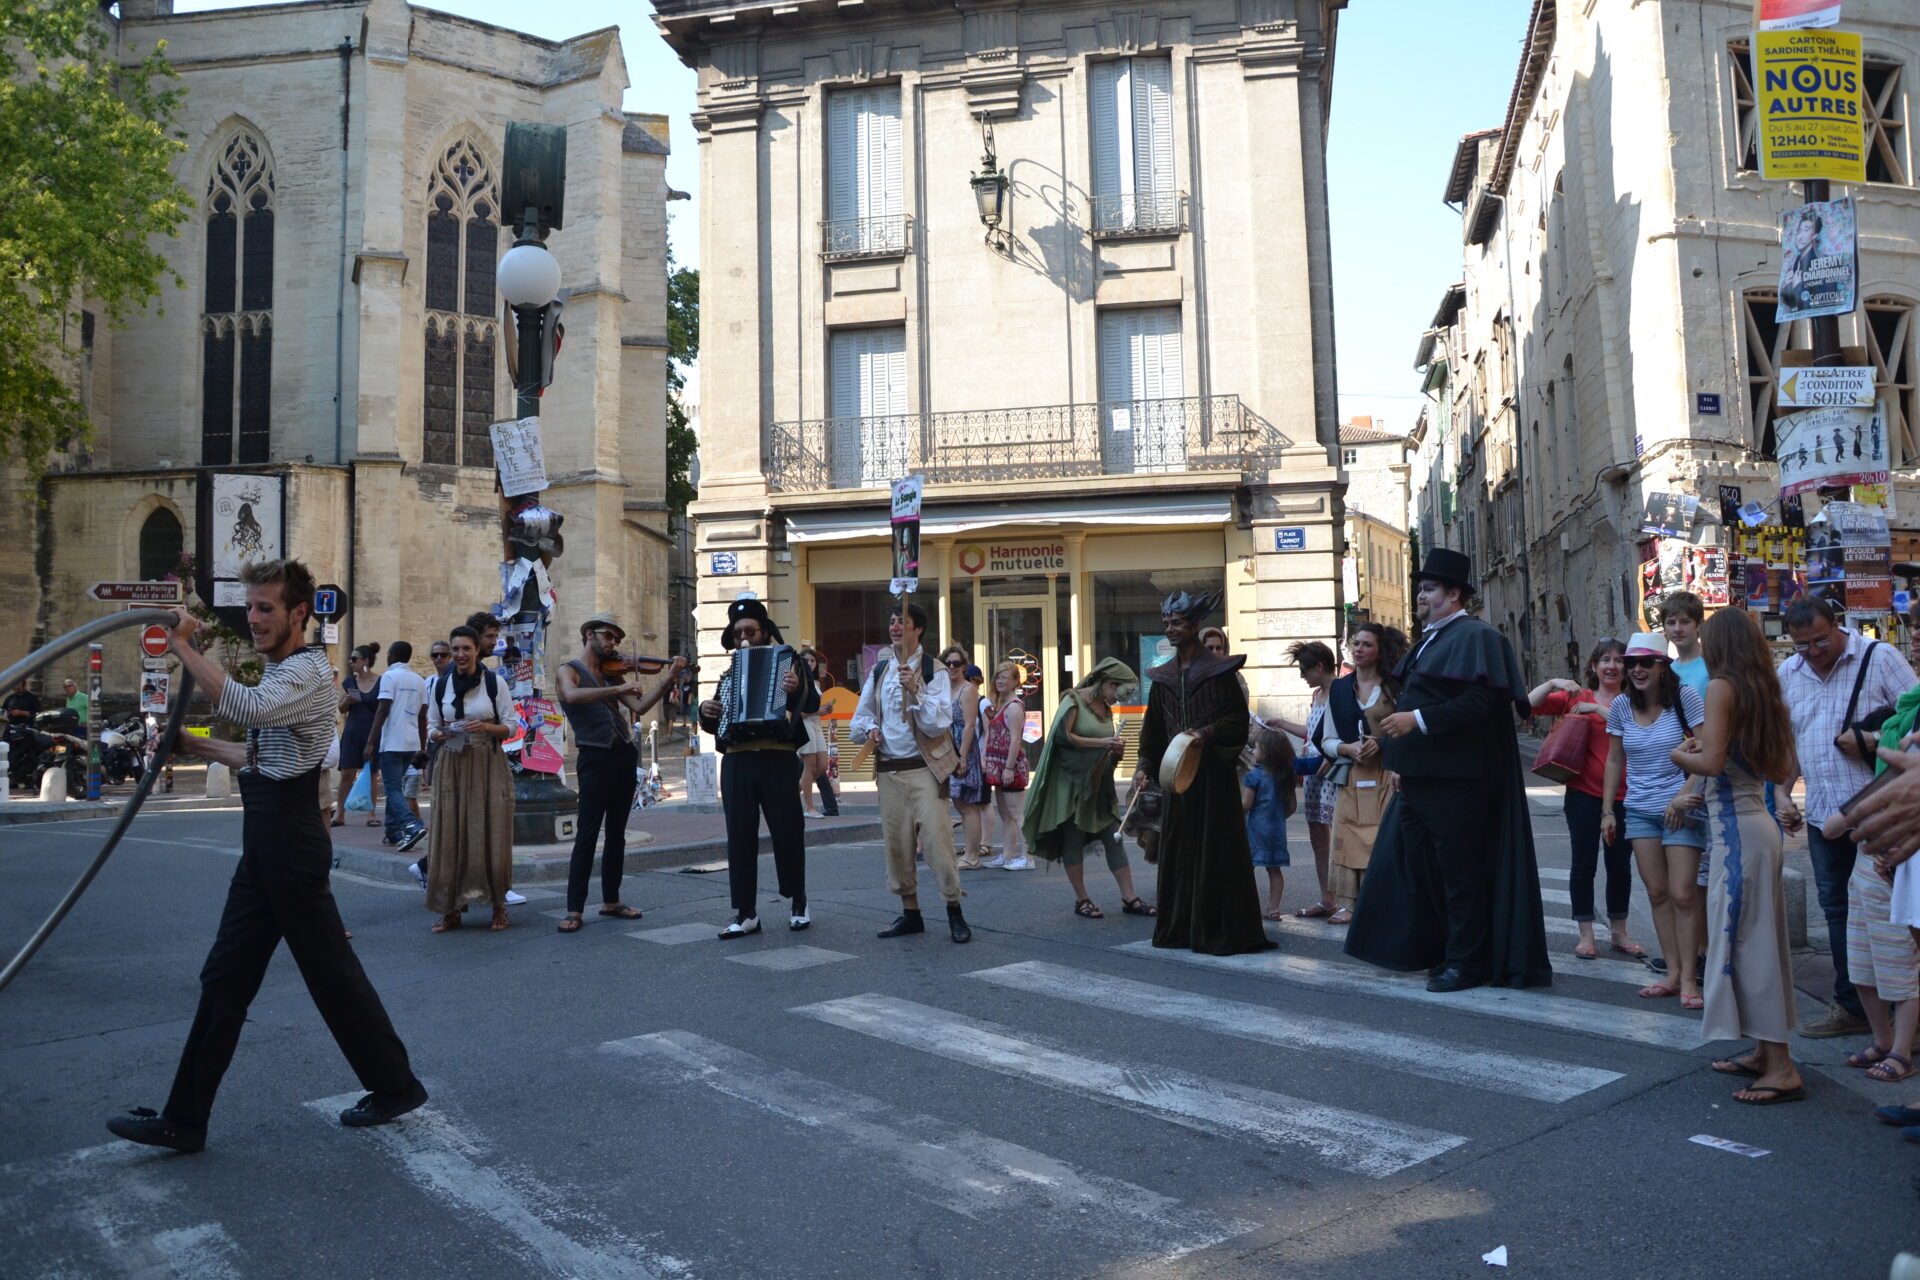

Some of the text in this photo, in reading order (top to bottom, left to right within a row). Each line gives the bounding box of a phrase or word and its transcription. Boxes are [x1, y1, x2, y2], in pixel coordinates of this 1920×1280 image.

[1789, 37, 1836, 45] CARTOUN
[1765, 45, 1856, 57] SARDINES THÉÂTRE
[1765, 64, 1857, 93] NOUS
[1768, 97, 1857, 116] AUTRES
[1769, 125, 1782, 133] Du
[1807, 123, 1818, 131] 27
[1821, 124, 1841, 133] juillet
[1843, 126, 1859, 134] 2014
[1770, 135, 1817, 147] 12H40
[1809, 254, 1843, 271] JEREMY
[1803, 266, 1850, 282] CHARBONNEL
[1807, 380, 1864, 390] CONDITION
[1812, 391, 1857, 405] SOIES
[990, 544, 1064, 559] Harmonie
[1844, 547, 1875, 555] JACQUES
[991, 557, 1064, 571] mutuelle
[1846, 581, 1879, 589] BARBARA
